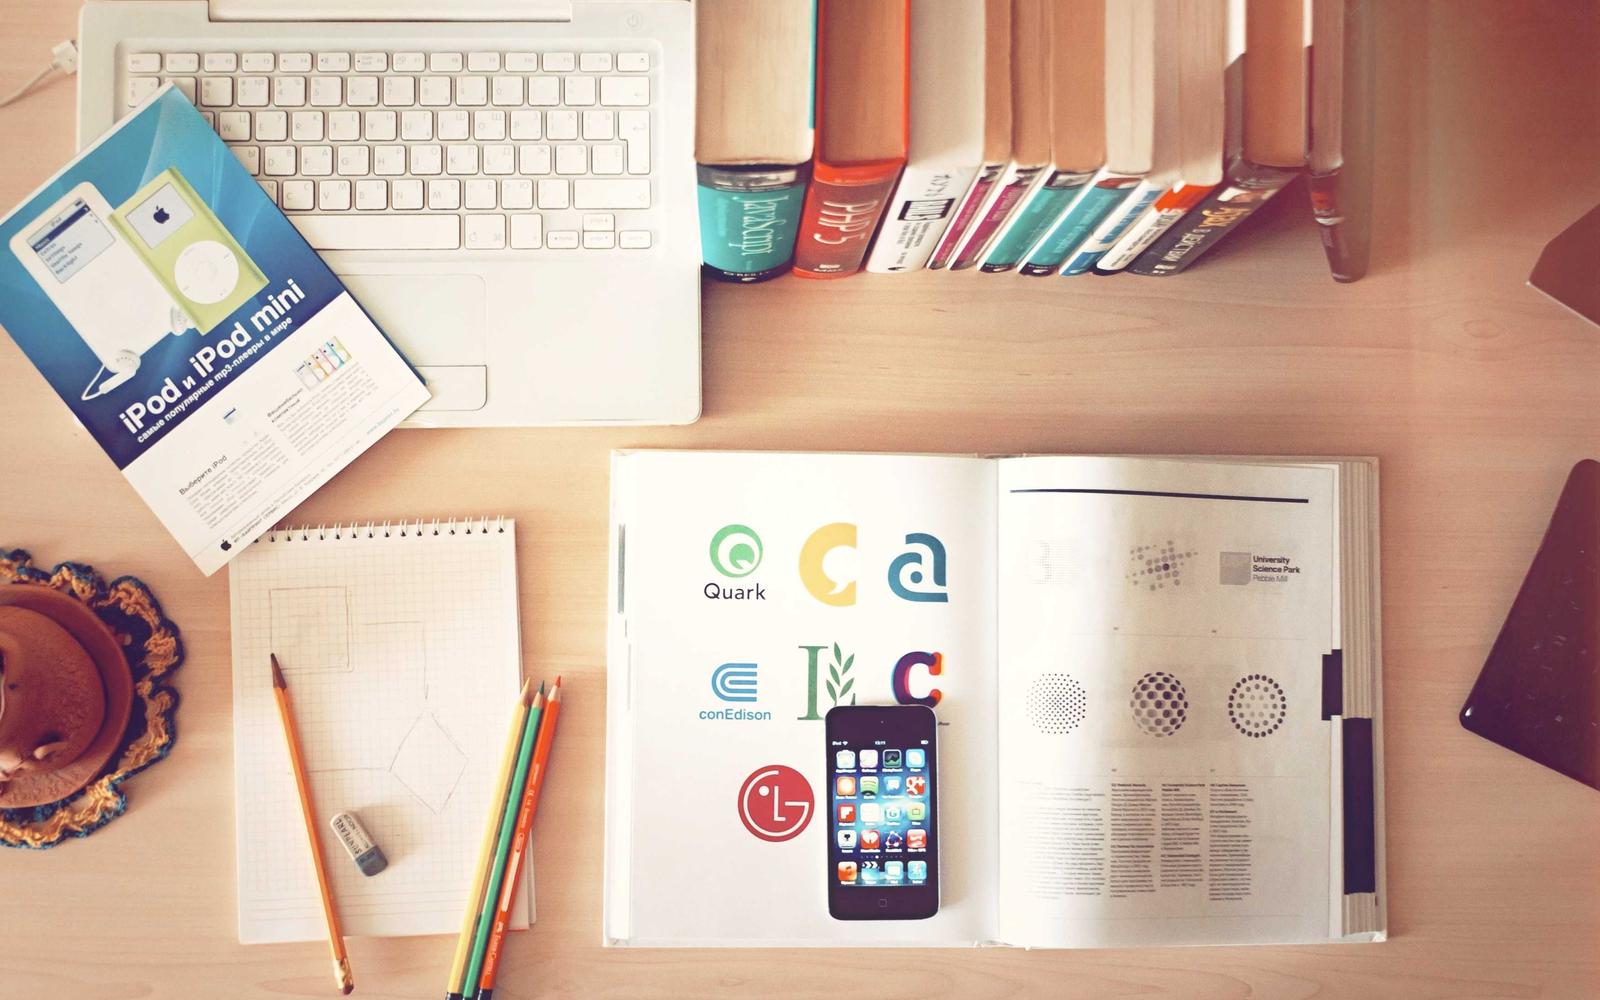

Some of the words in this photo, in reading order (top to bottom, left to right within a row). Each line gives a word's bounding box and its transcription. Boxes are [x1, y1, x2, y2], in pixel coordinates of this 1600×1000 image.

[728, 195, 789, 256] JavaScript
[818, 200, 879, 232] PHP
[813, 233, 866, 245] 5
[119, 377, 182, 434] iPod
[182, 375, 196, 390] и
[189, 322, 252, 377] iPod
[250, 278, 306, 332] mini
[137, 419, 165, 443] самые
[164, 379, 215, 422] популярные
[213, 339, 265, 382] mp3-плееры
[264, 334, 271, 342] в
[270, 317, 293, 337] мире
[179, 467, 212, 495] Выберите
[212, 455, 228, 469] iPod
[1253, 555, 1290, 565] University
[1253, 565, 1282, 573] Science
[704, 582, 766, 600] Quark
[699, 708, 772, 721] conEdison
[743, 770, 809, 837] LG
